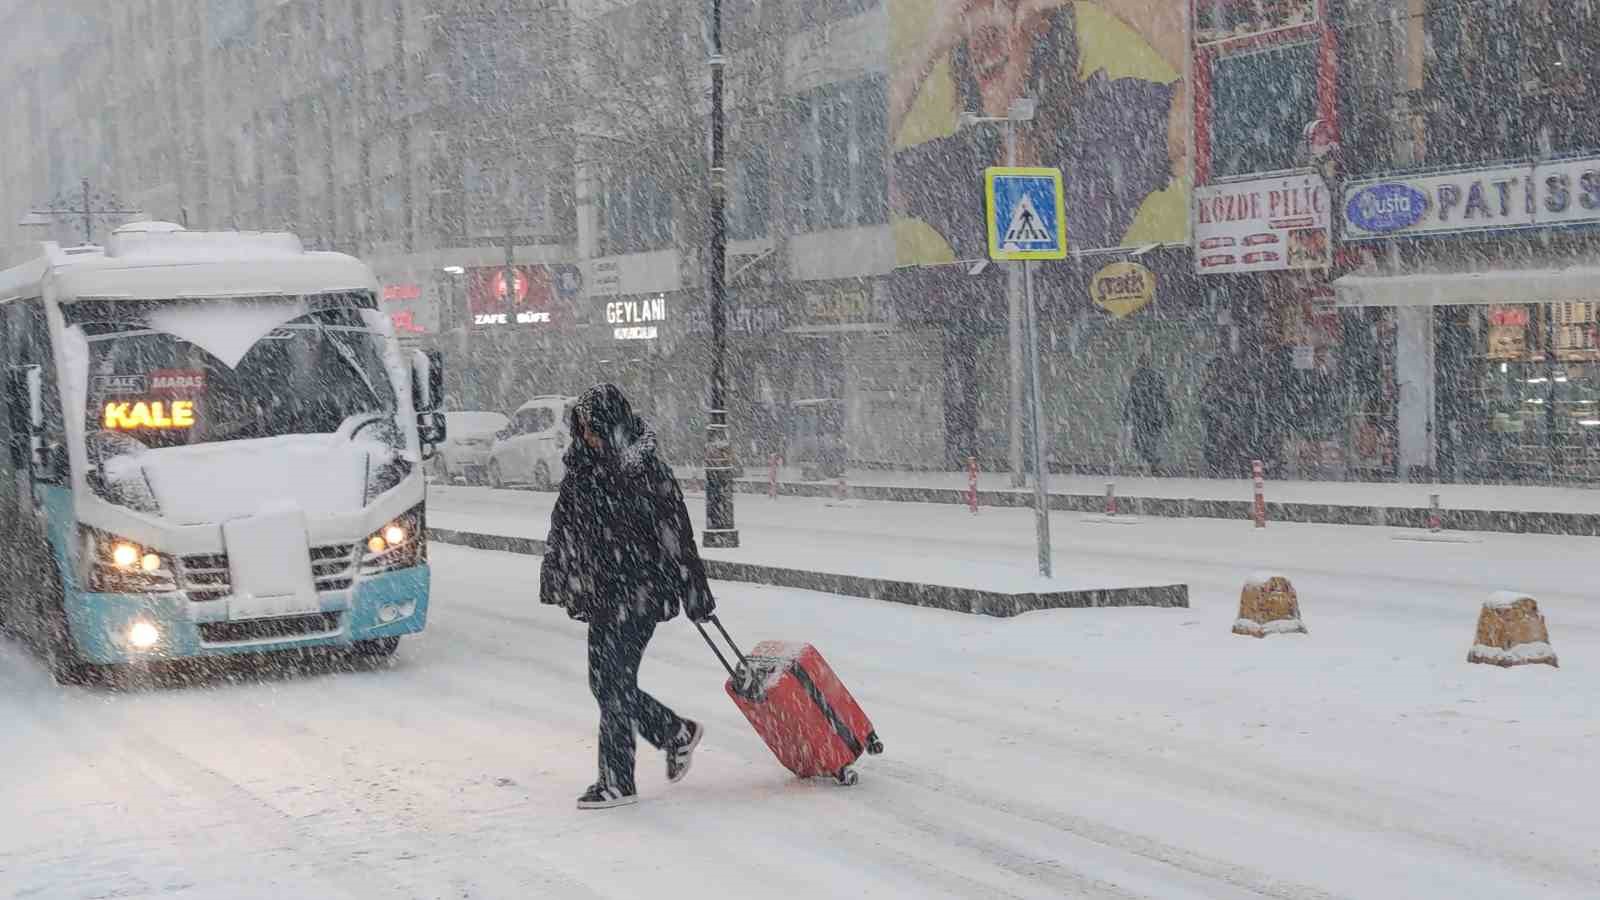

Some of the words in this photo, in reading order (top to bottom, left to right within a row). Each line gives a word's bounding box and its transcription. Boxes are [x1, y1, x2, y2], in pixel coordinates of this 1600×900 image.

[1199, 191, 1264, 224] KÖZDE
[1268, 179, 1327, 226] PİLİÇ
[474, 313, 509, 325] ZAFE
[606, 293, 666, 324] GEYLANİ
[104, 400, 195, 428] KALE
